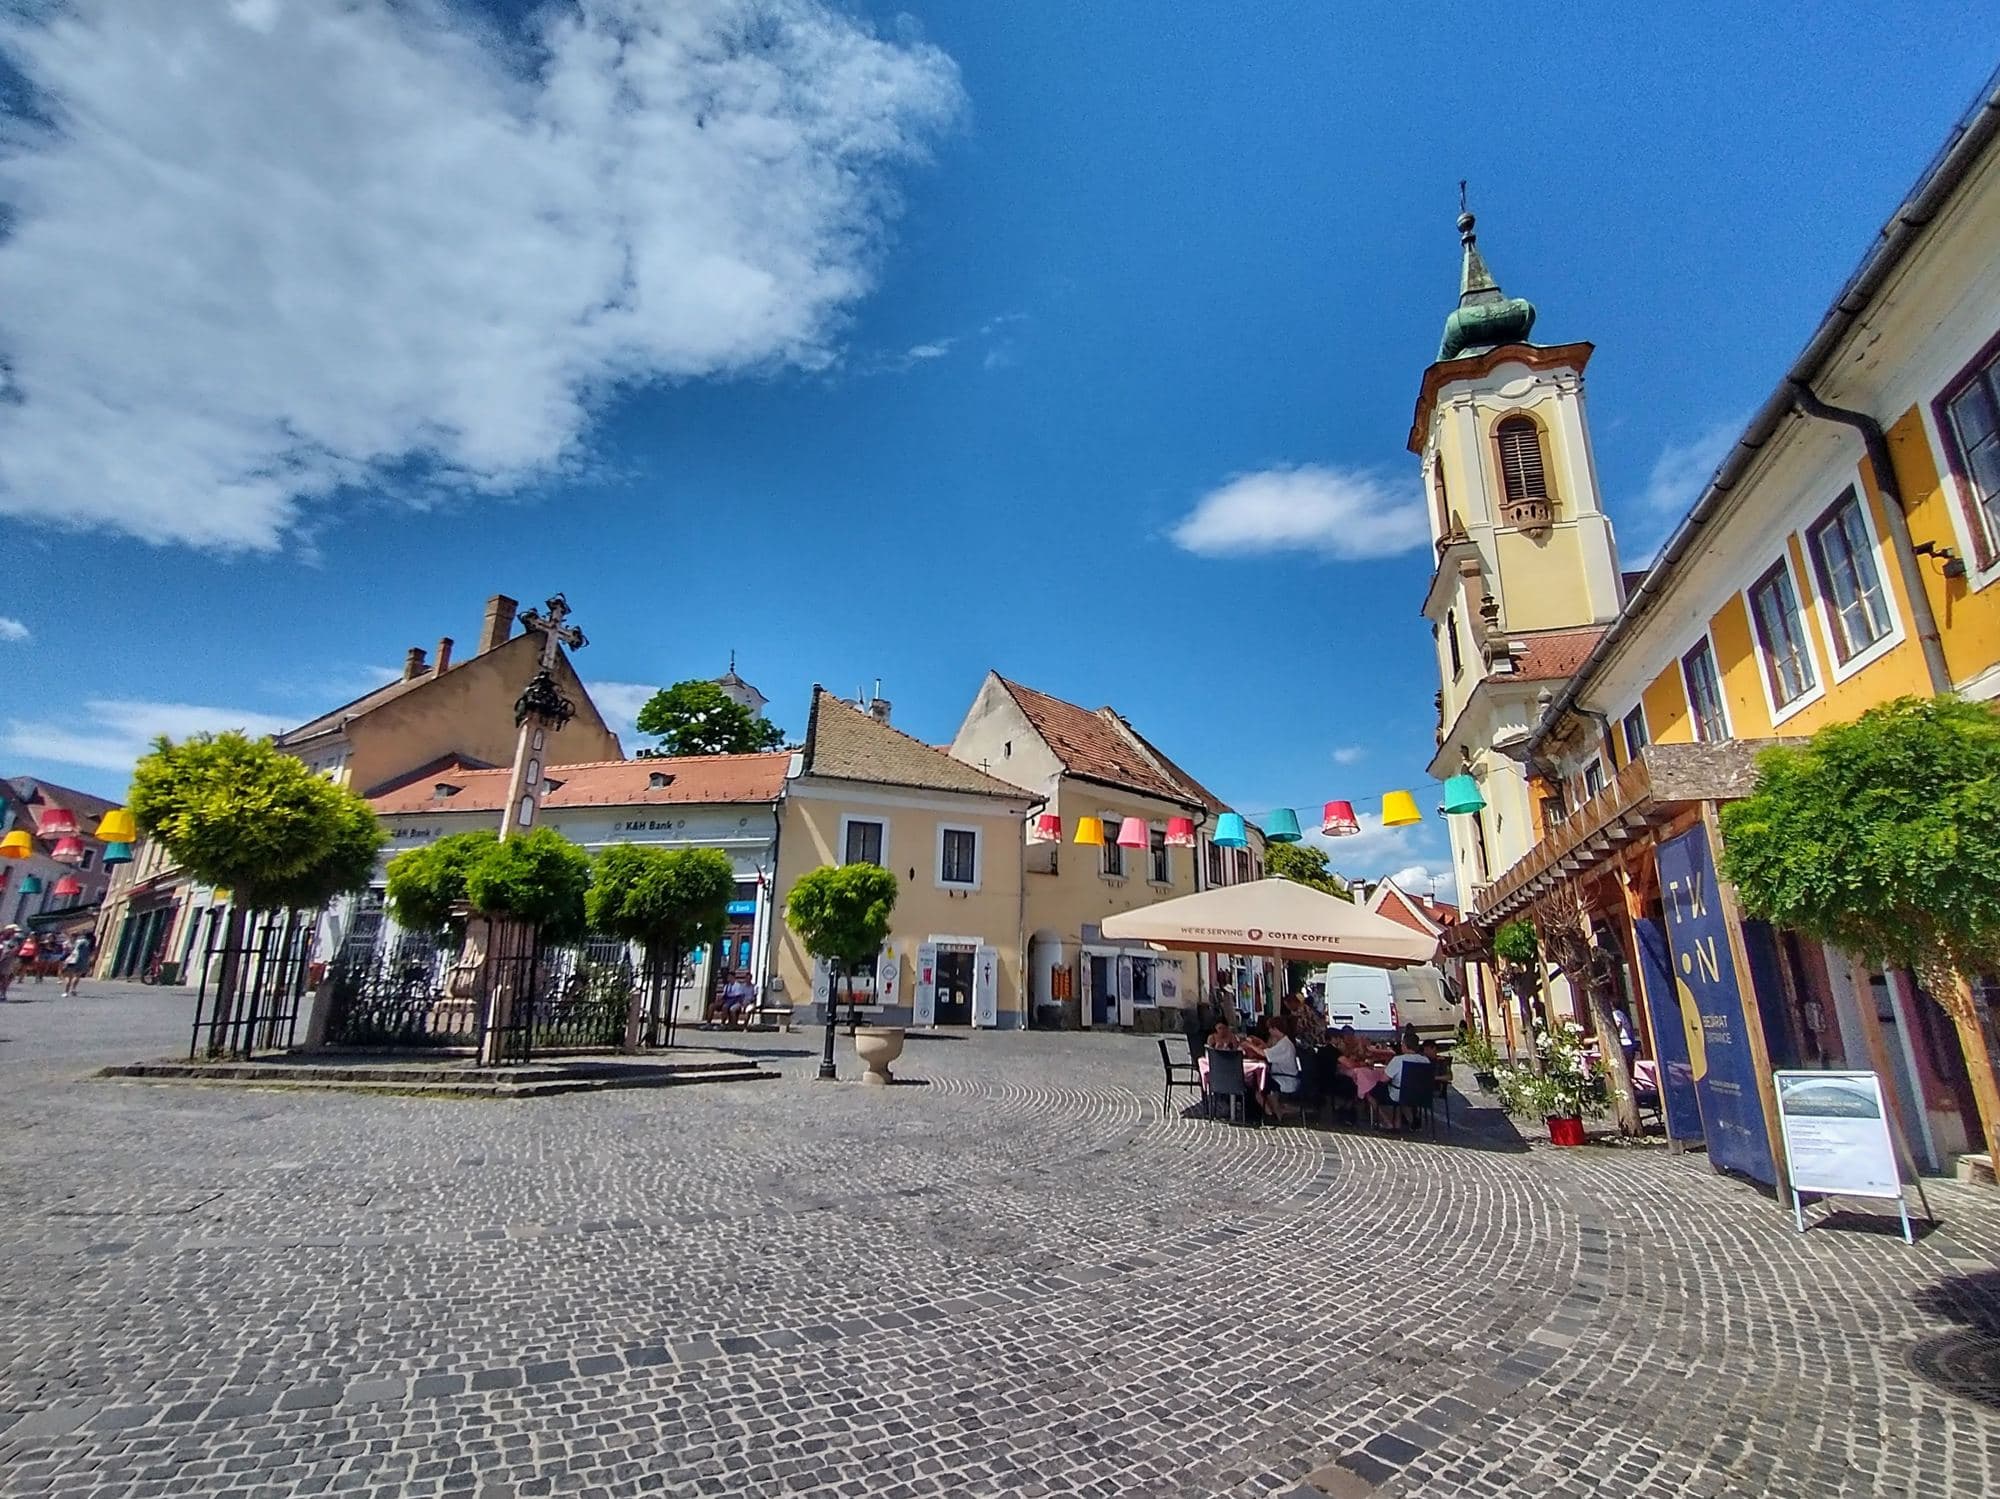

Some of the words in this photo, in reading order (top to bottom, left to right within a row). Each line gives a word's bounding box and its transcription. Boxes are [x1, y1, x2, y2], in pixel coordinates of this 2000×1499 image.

[625, 821, 646, 831] K&H
[649, 820, 672, 831] Bank
[1207, 928, 1243, 937] SERVING
[1268, 931, 1298, 940] COSTA
[1301, 934, 1341, 944] COFFEE
